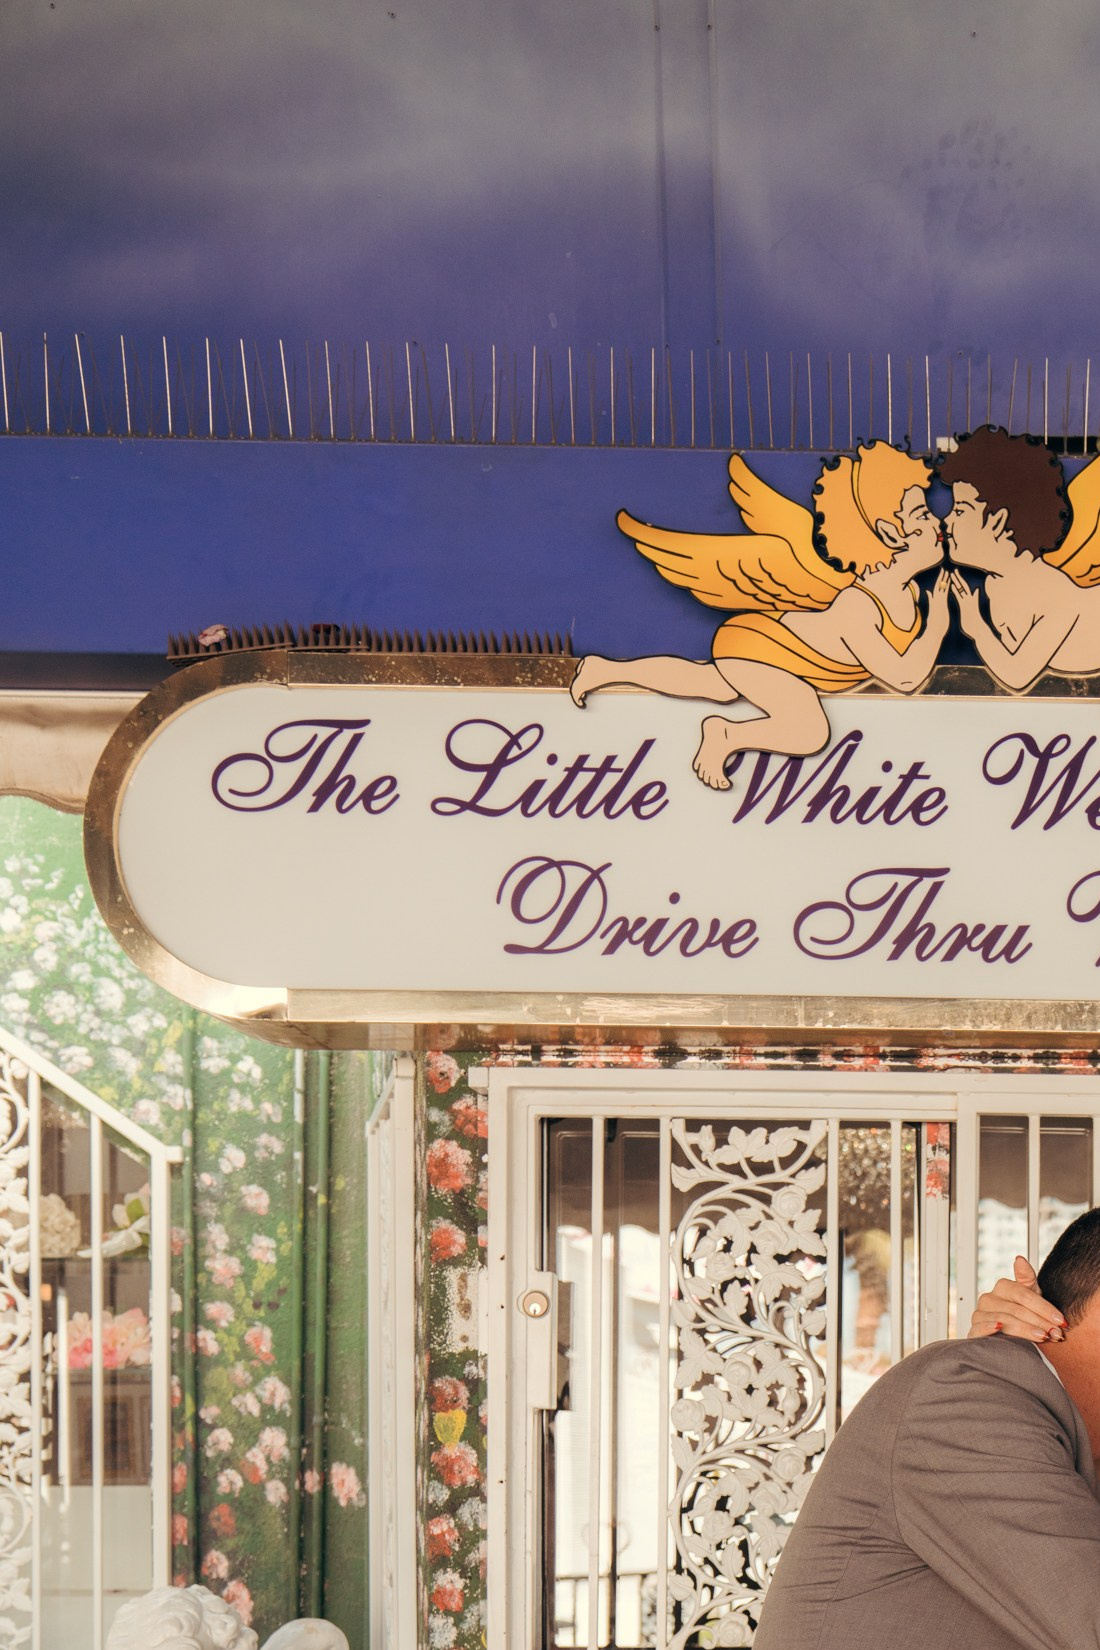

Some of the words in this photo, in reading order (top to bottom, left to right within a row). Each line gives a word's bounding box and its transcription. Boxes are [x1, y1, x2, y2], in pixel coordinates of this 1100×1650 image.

[210, 718, 400, 816] The
[431, 718, 670, 821] Little
[724, 729, 949, 827] White
[496, 855, 759, 959] Drive
[793, 866, 1033, 964] Thru
